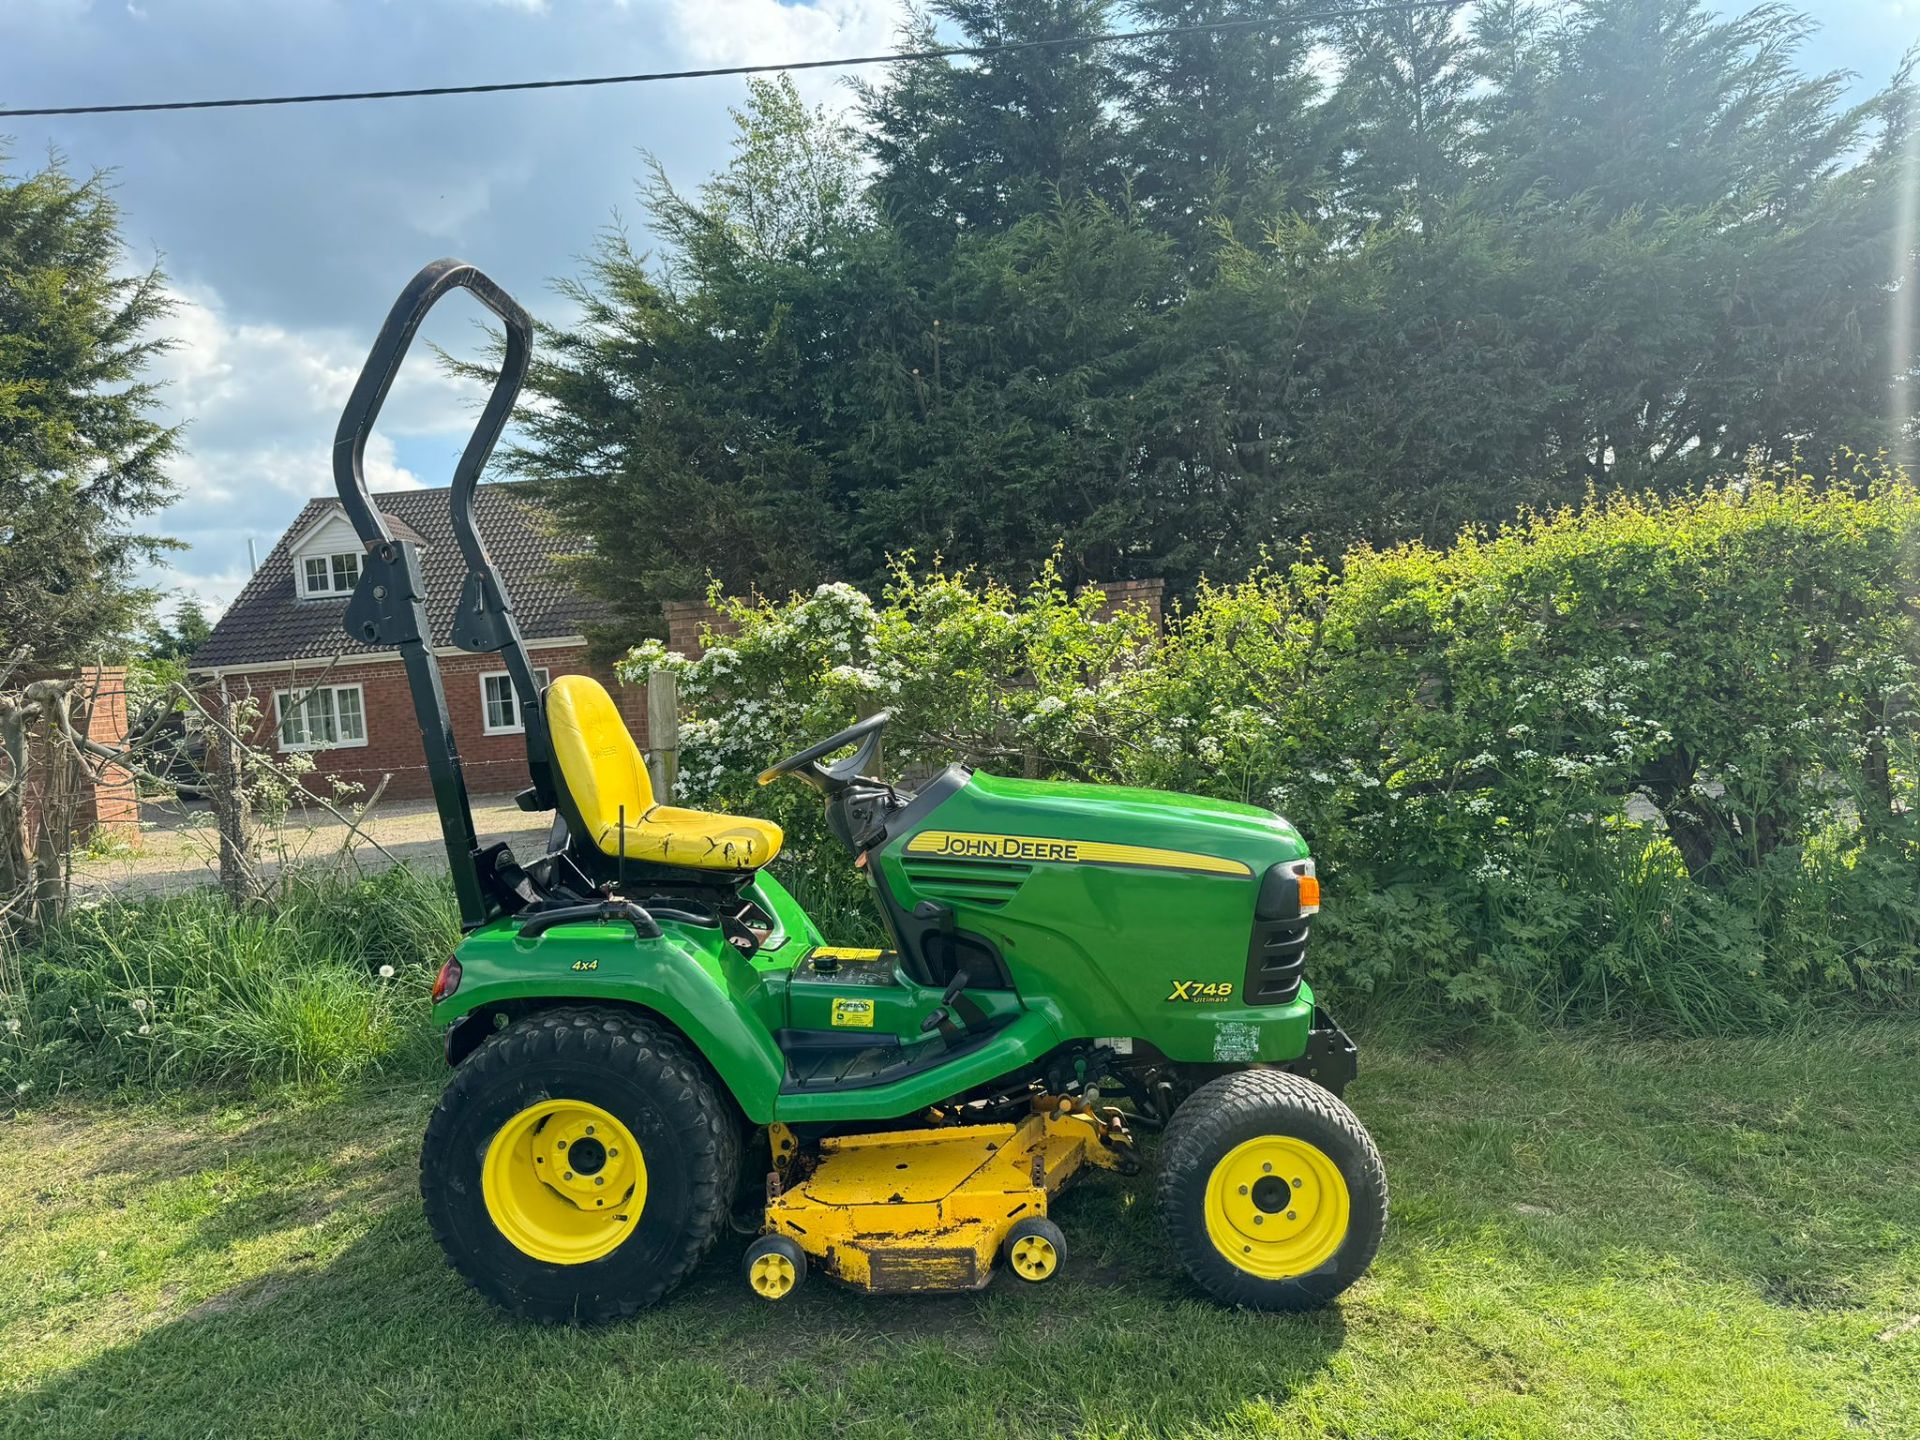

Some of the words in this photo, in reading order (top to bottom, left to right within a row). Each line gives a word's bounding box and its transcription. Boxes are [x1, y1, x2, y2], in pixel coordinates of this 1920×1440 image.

[937, 835, 997, 855] JOHN
[1003, 838, 1078, 859] DEERE
[571, 959, 599, 971] 4x4
[1167, 980, 1233, 1000] X748
